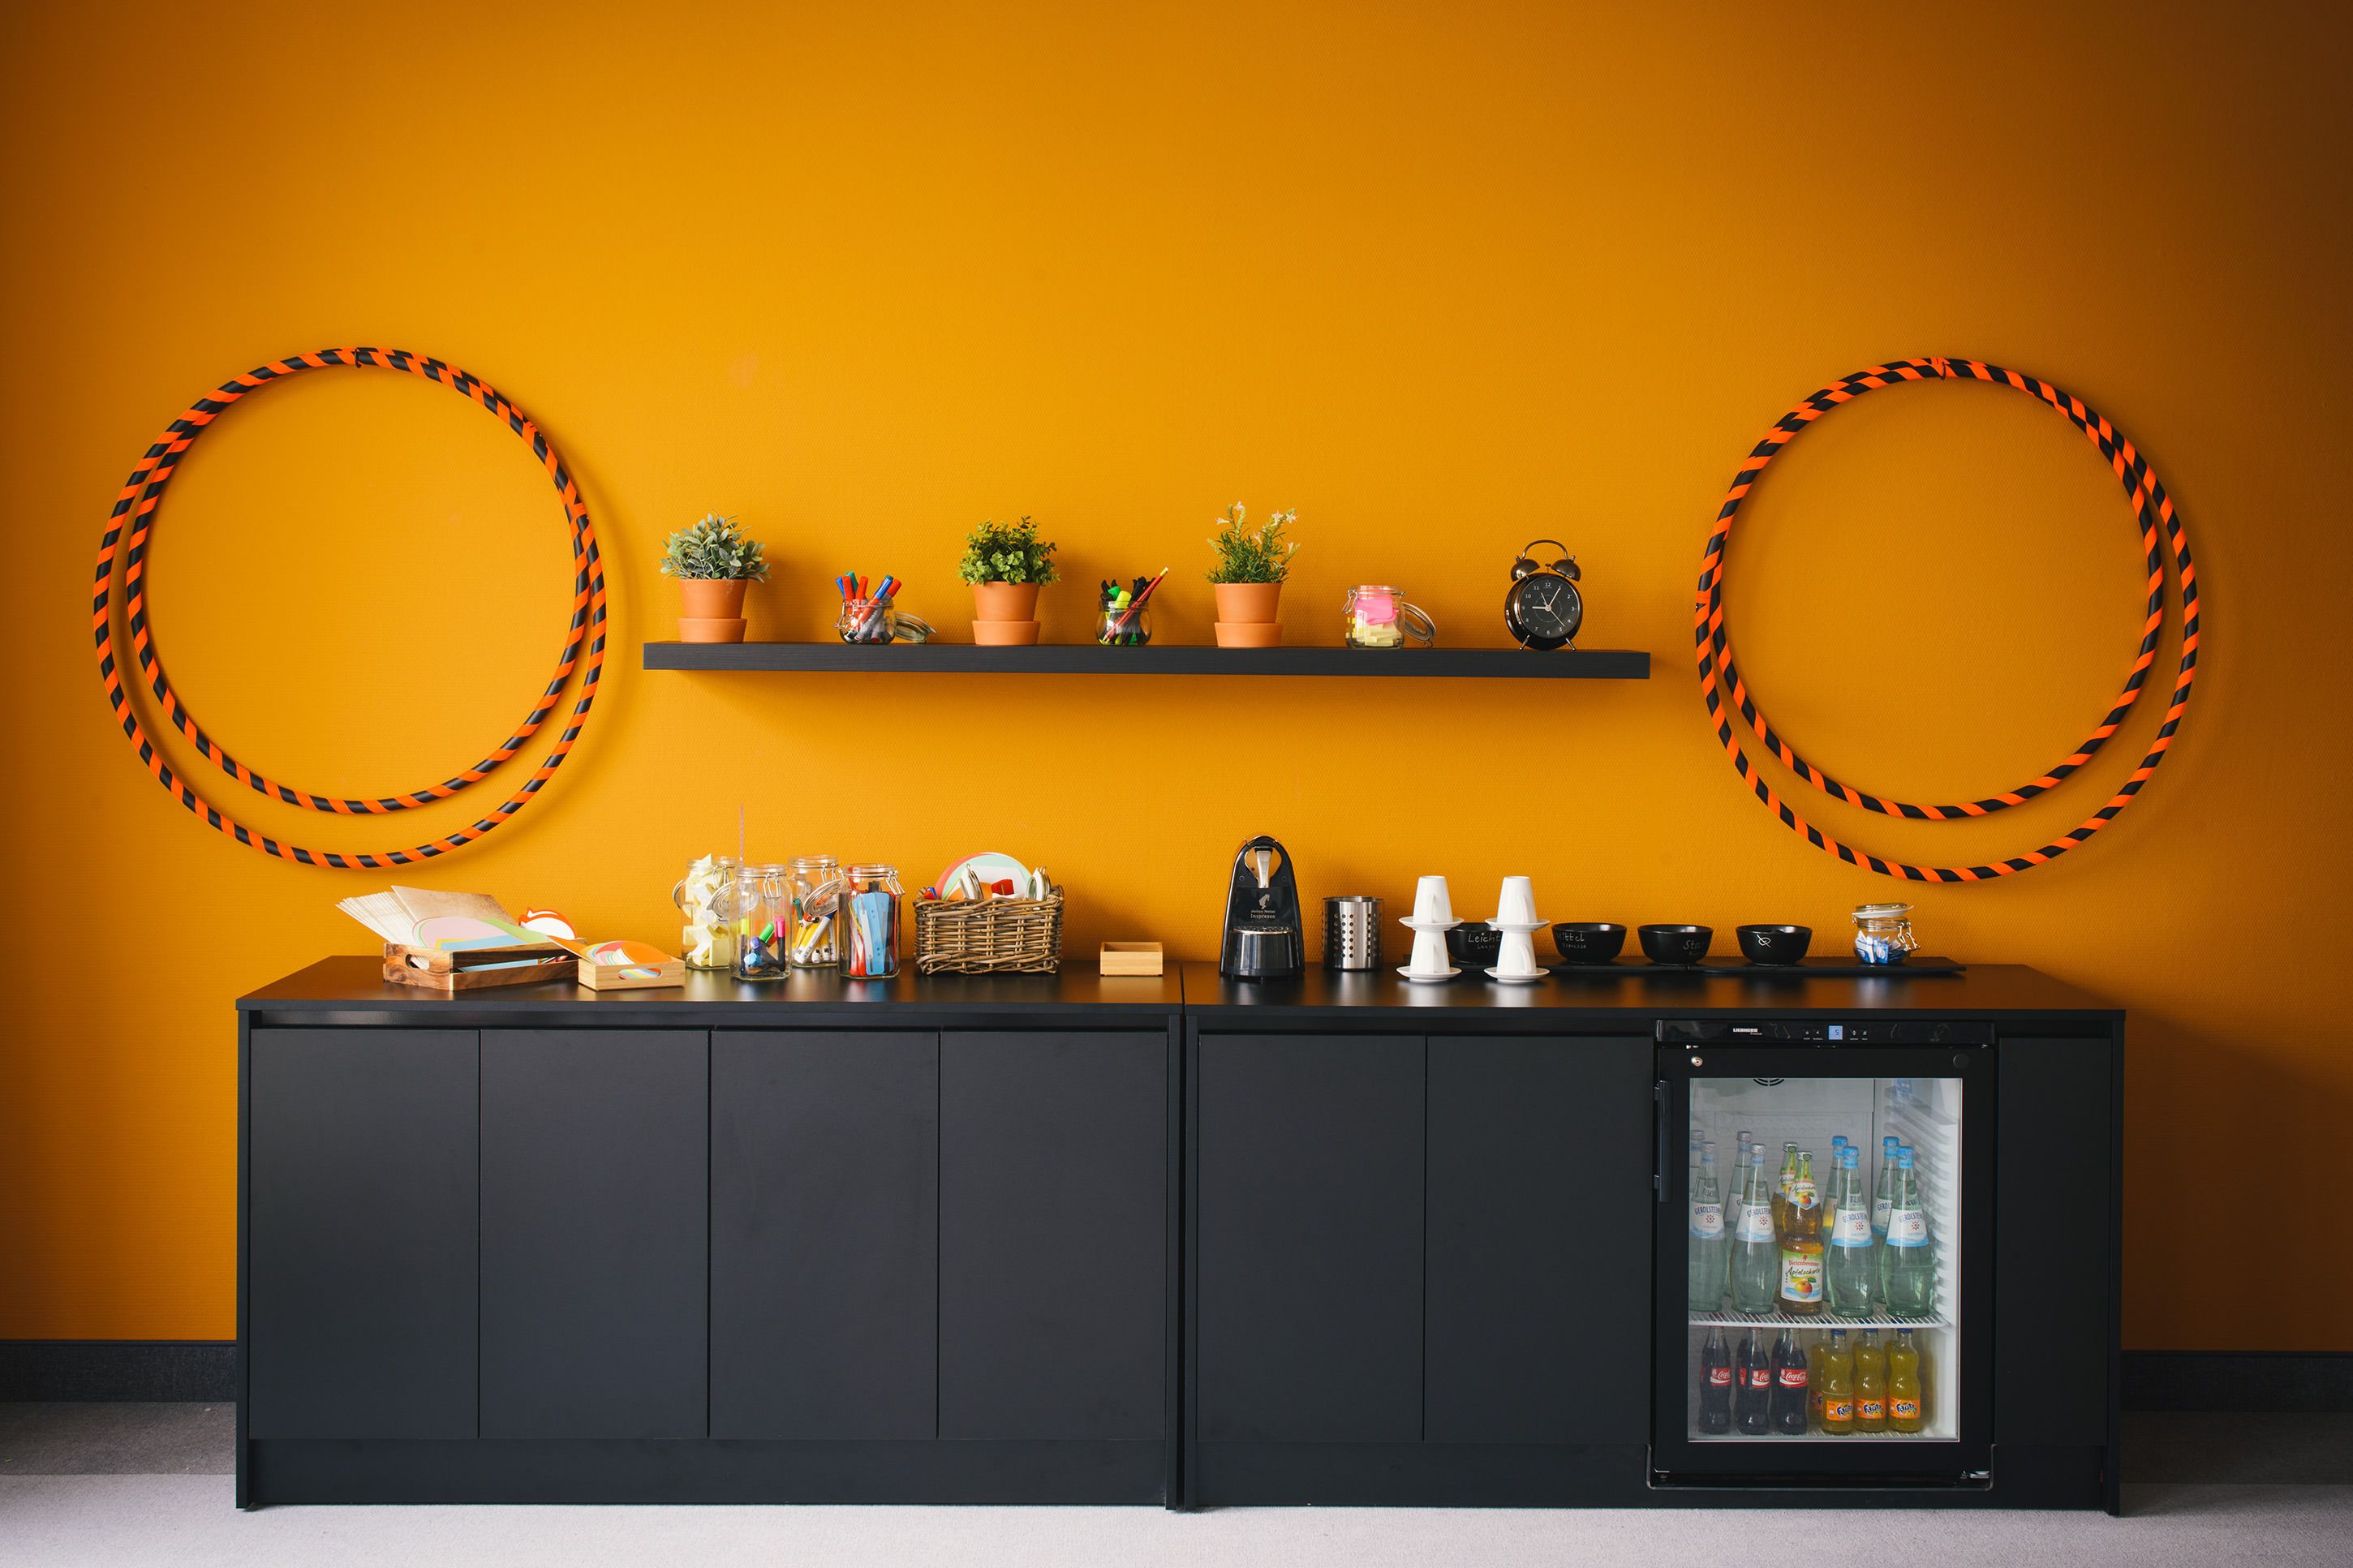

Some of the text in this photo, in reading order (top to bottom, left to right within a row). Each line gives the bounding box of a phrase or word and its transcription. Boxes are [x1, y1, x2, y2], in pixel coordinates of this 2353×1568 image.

[1468, 931, 1500, 943] Leicht
[1863, 1403, 1882, 1414] Fanta
[1896, 1403, 1915, 1413] Fanta
